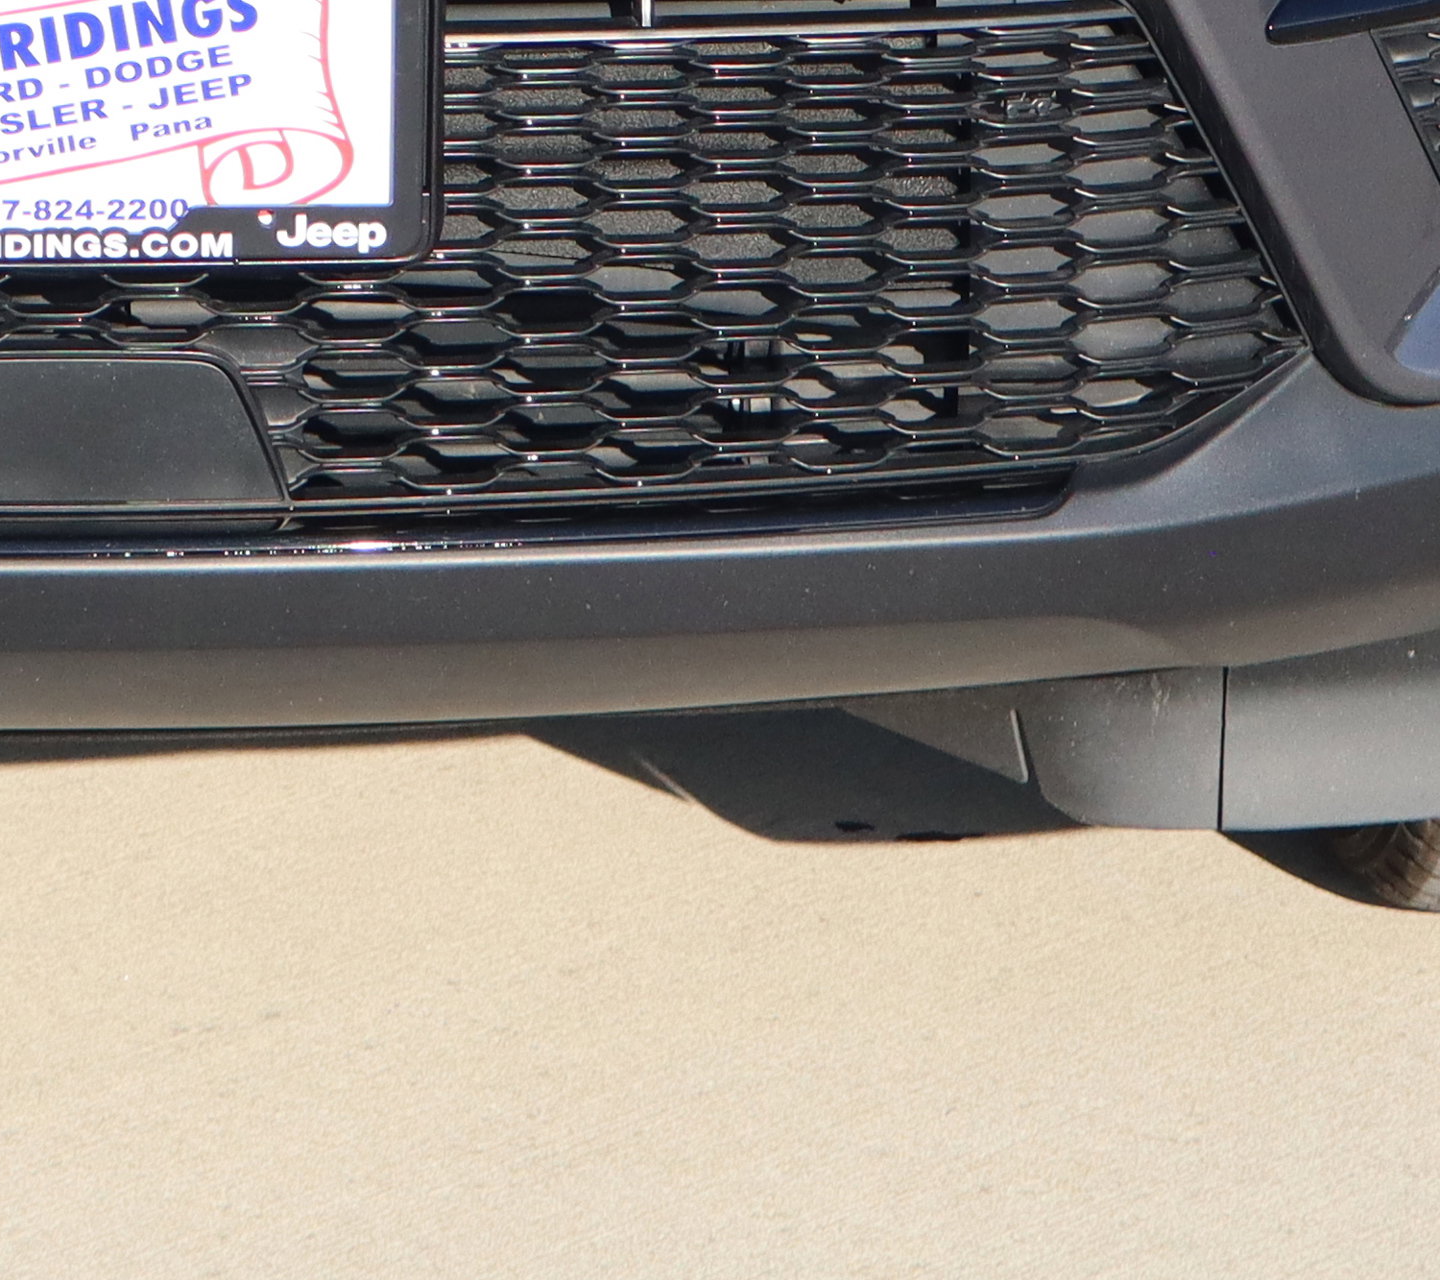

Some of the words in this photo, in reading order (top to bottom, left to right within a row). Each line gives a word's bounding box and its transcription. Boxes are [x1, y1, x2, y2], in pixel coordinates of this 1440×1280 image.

[84, 44, 233, 90] DODGE
[148, 73, 252, 111] JEEP
[129, 115, 213, 141] Pana
[276, 213, 387, 254] Jeep
